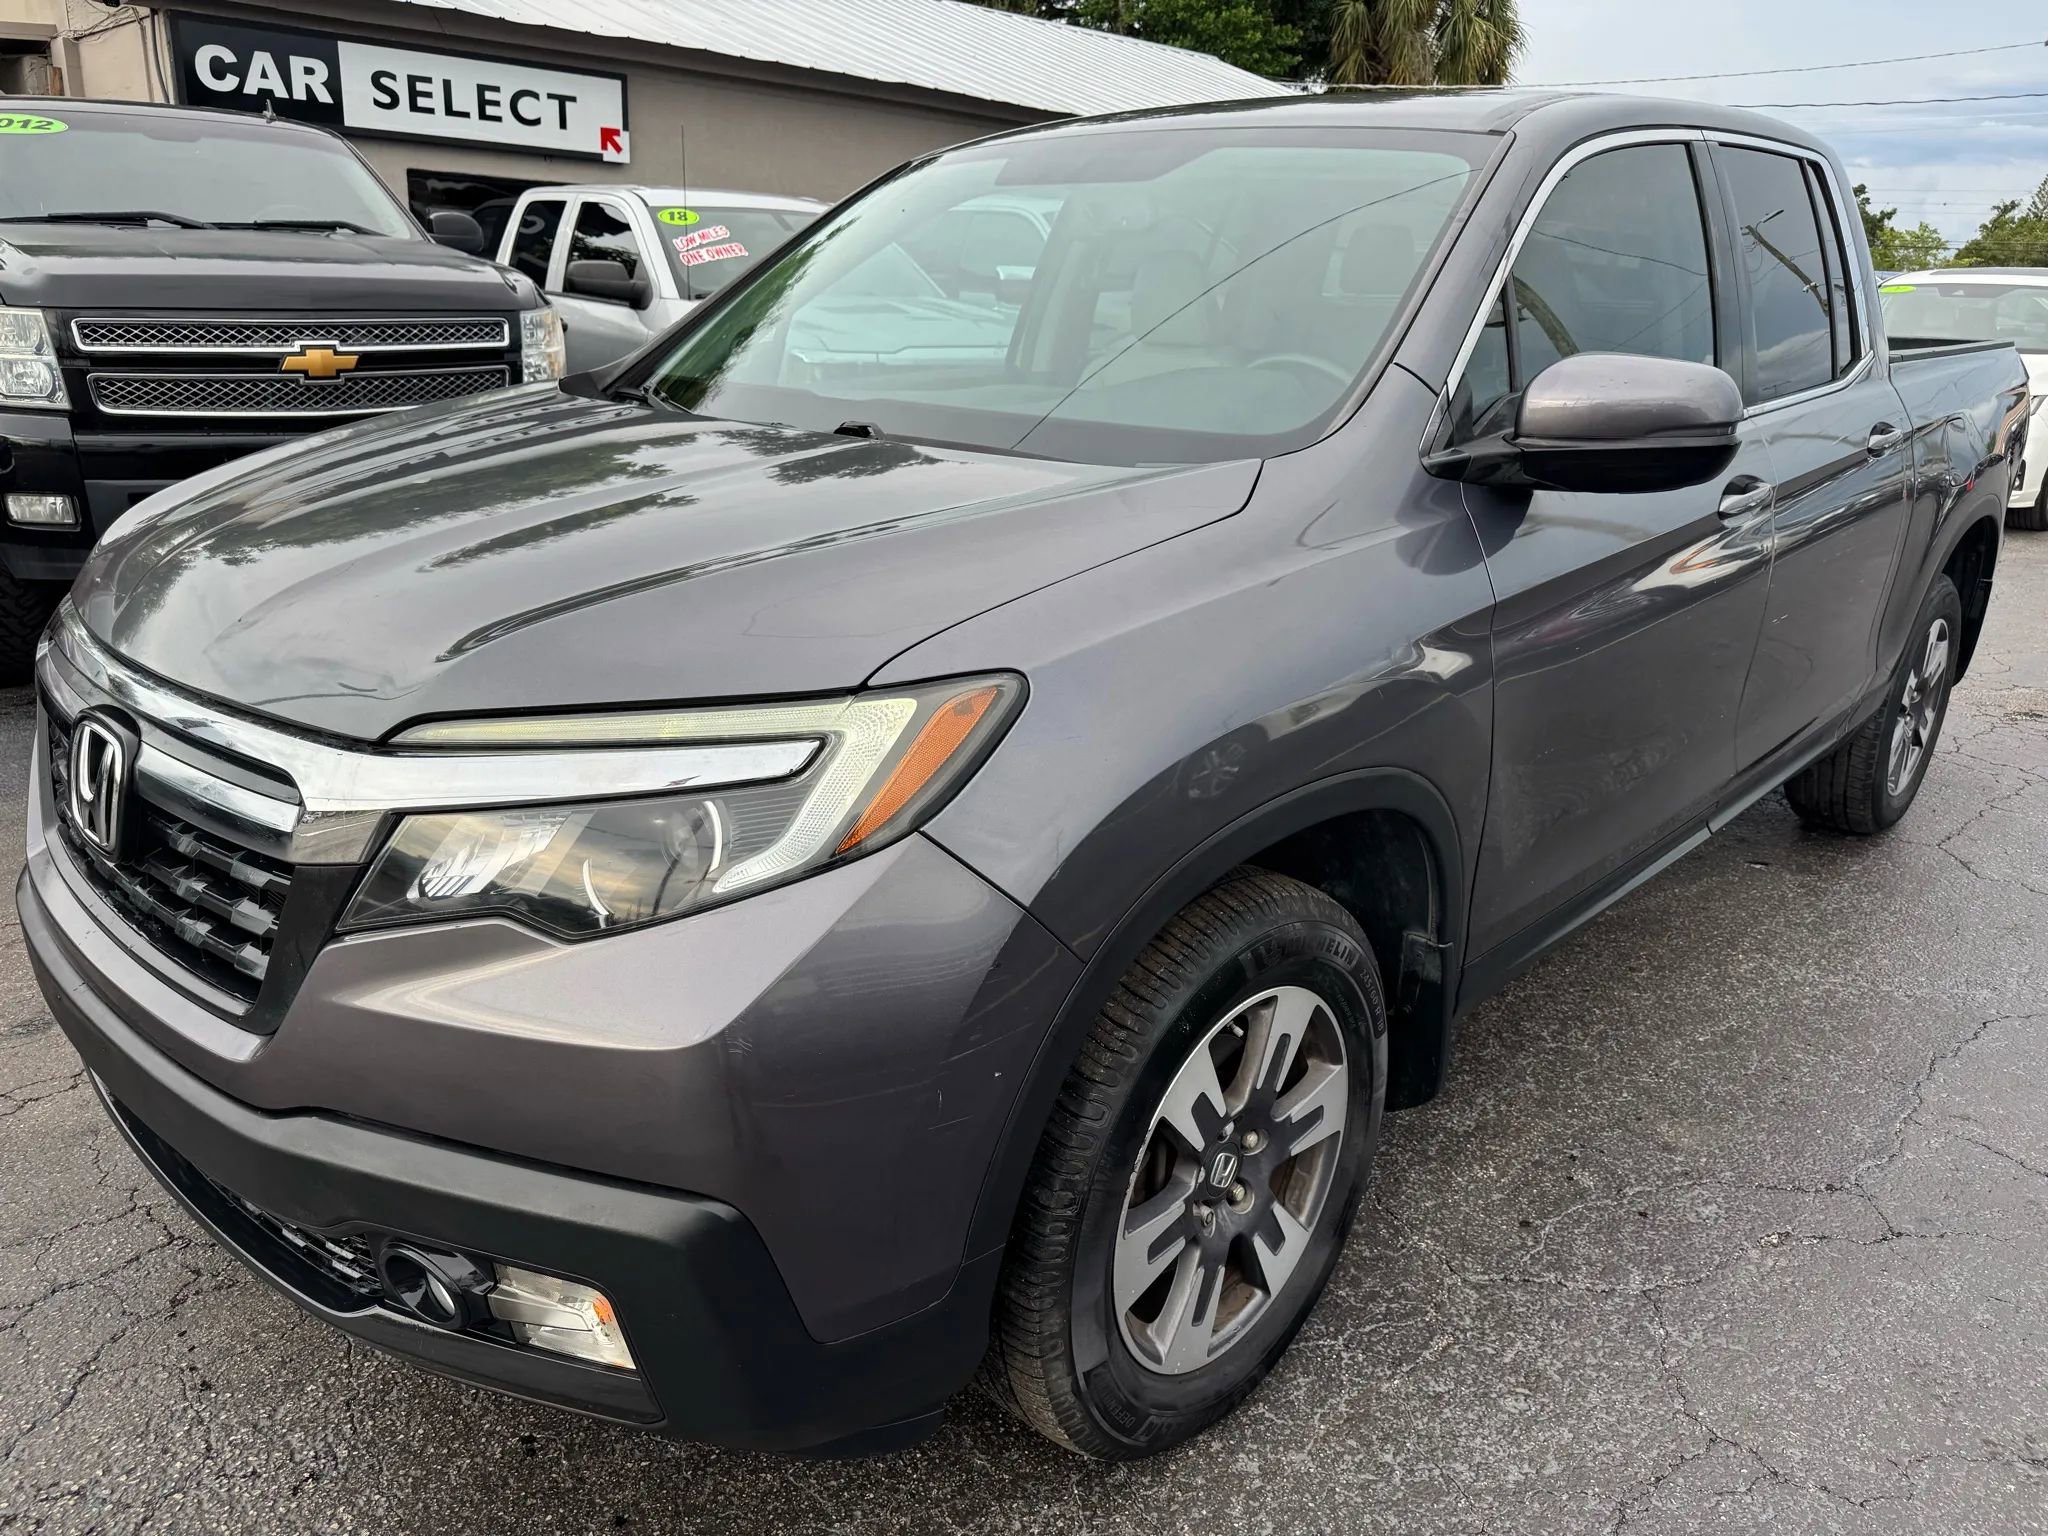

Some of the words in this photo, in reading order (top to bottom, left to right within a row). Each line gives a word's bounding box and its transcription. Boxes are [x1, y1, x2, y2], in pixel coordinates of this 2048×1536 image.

[194, 44, 334, 104] CAR
[370, 70, 578, 131] SELECT
[668, 211, 688, 221] 18
[681, 251, 706, 265] ONE
